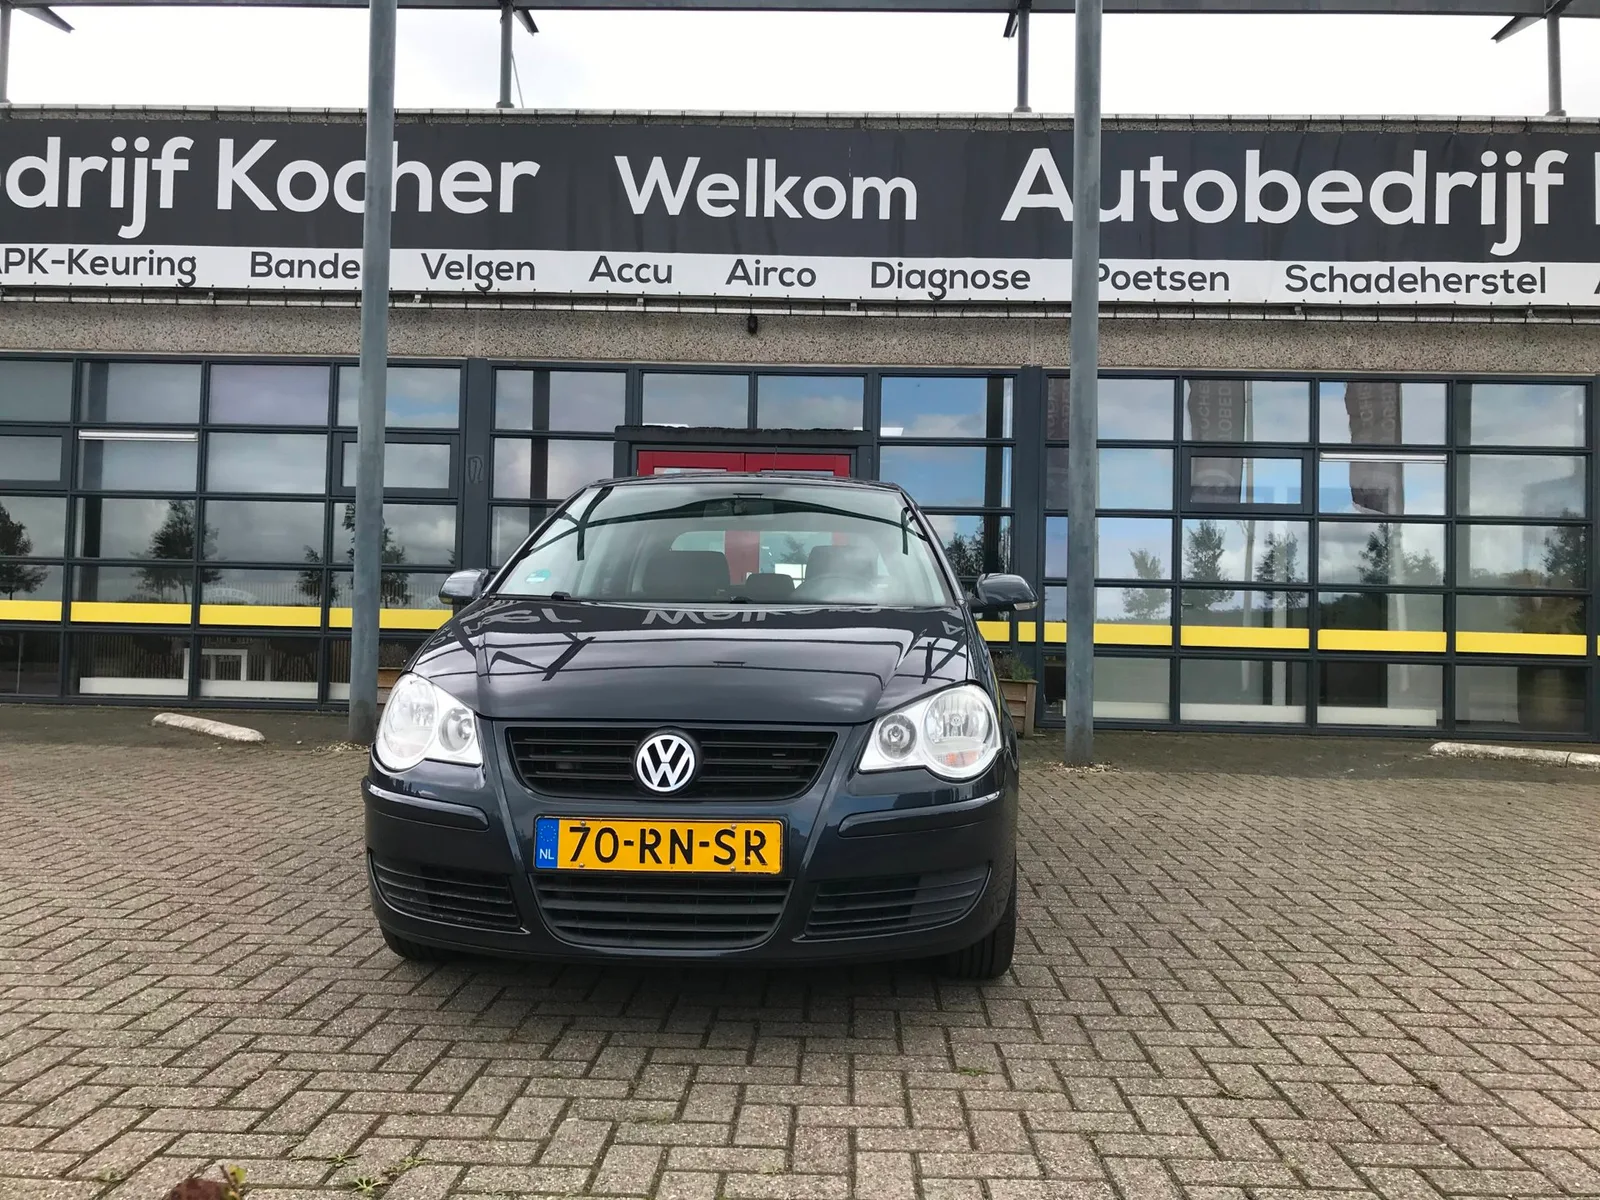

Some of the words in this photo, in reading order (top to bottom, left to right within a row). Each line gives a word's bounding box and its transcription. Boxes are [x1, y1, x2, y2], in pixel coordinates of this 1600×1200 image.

[0, 137, 194, 239] drijf
[218, 139, 540, 213] Kocher
[615, 155, 917, 220] Welkom
[1001, 148, 1568, 257] Autobedrijf
[0, 248, 197, 287] PK-Keuring
[251, 251, 360, 280] Bande
[421, 253, 534, 291] Velgen
[589, 256, 672, 283] Accu
[726, 259, 816, 287] Airco
[872, 262, 1030, 299] Diagnose
[1286, 265, 1545, 294] Schadeherstel
[636, 734, 695, 792] VW
[539, 849, 554, 860] NL
[569, 826, 767, 866] 70-RN-SR
